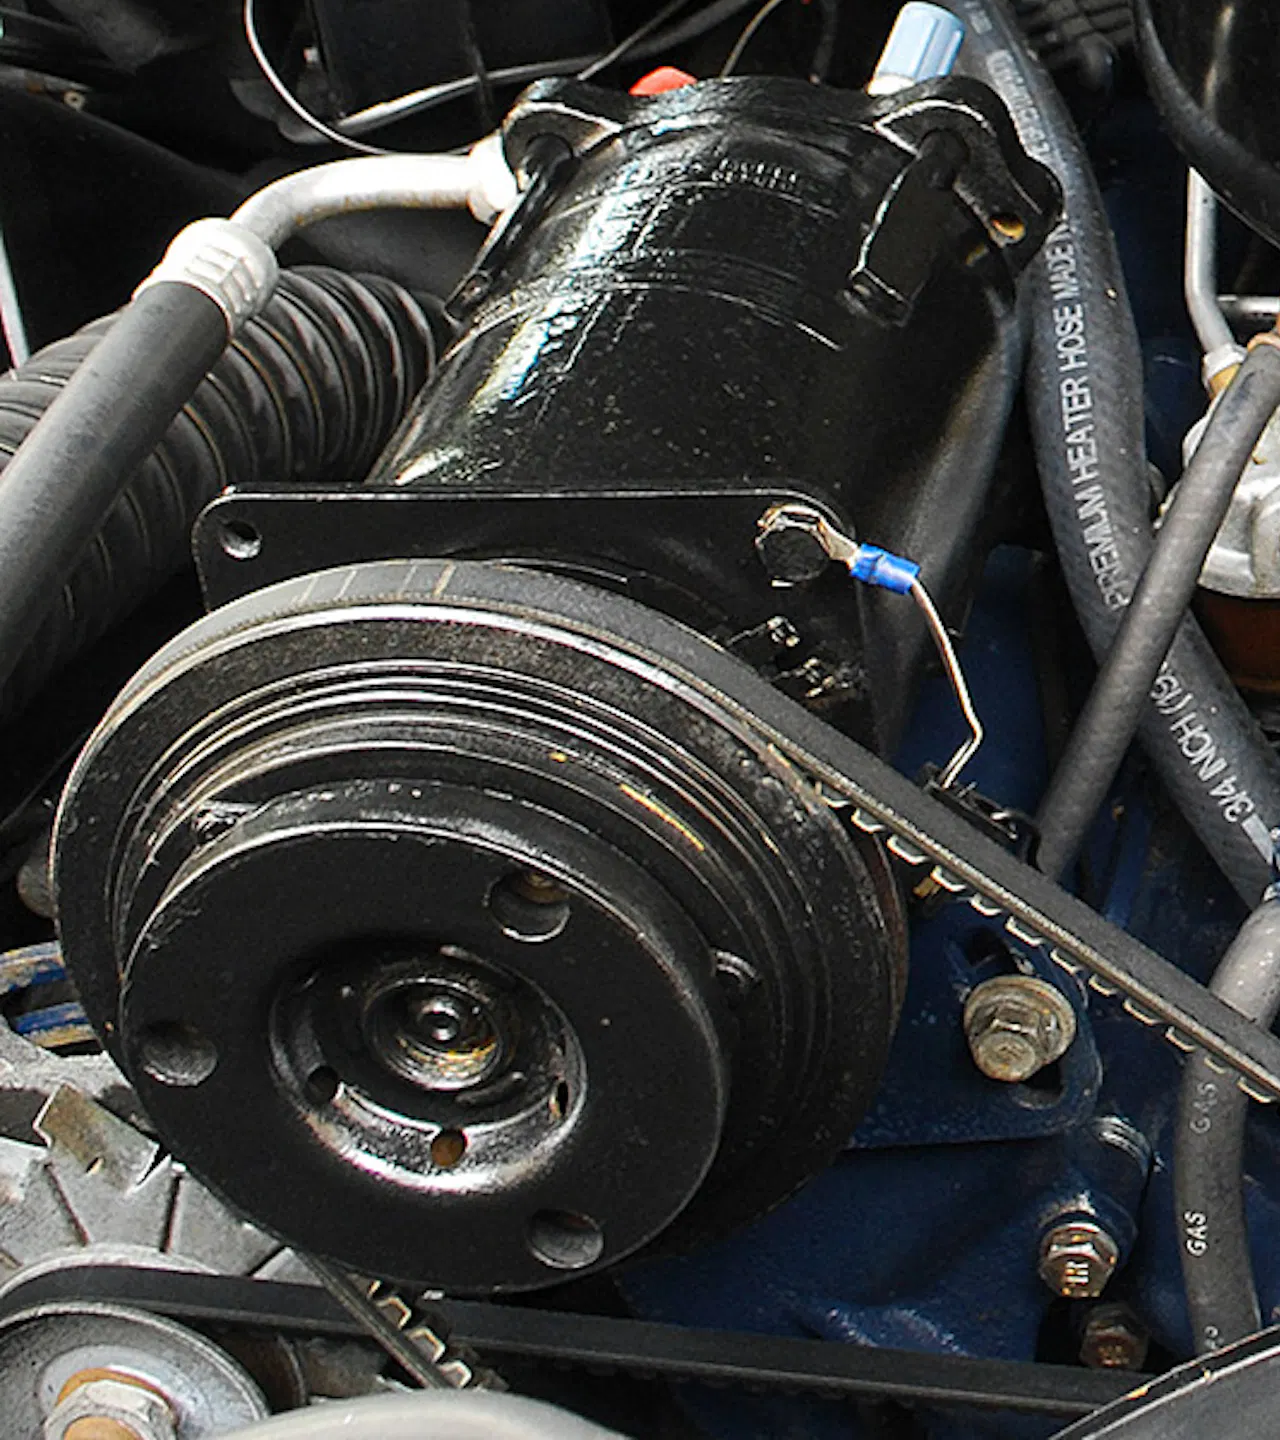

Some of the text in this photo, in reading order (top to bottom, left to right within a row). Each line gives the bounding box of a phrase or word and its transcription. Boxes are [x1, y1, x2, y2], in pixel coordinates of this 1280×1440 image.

[1046, 243, 1081, 301] MADE
[1053, 304, 1088, 373] HOSE
[1060, 375, 1100, 485] HEATER
[1075, 485, 1131, 611] PREMIUM
[1169, 711, 1228, 782] INCH
[1209, 774, 1255, 823] 3/4
[1188, 1081, 1218, 1135] GAS
[1183, 1209, 1208, 1257] GAS
